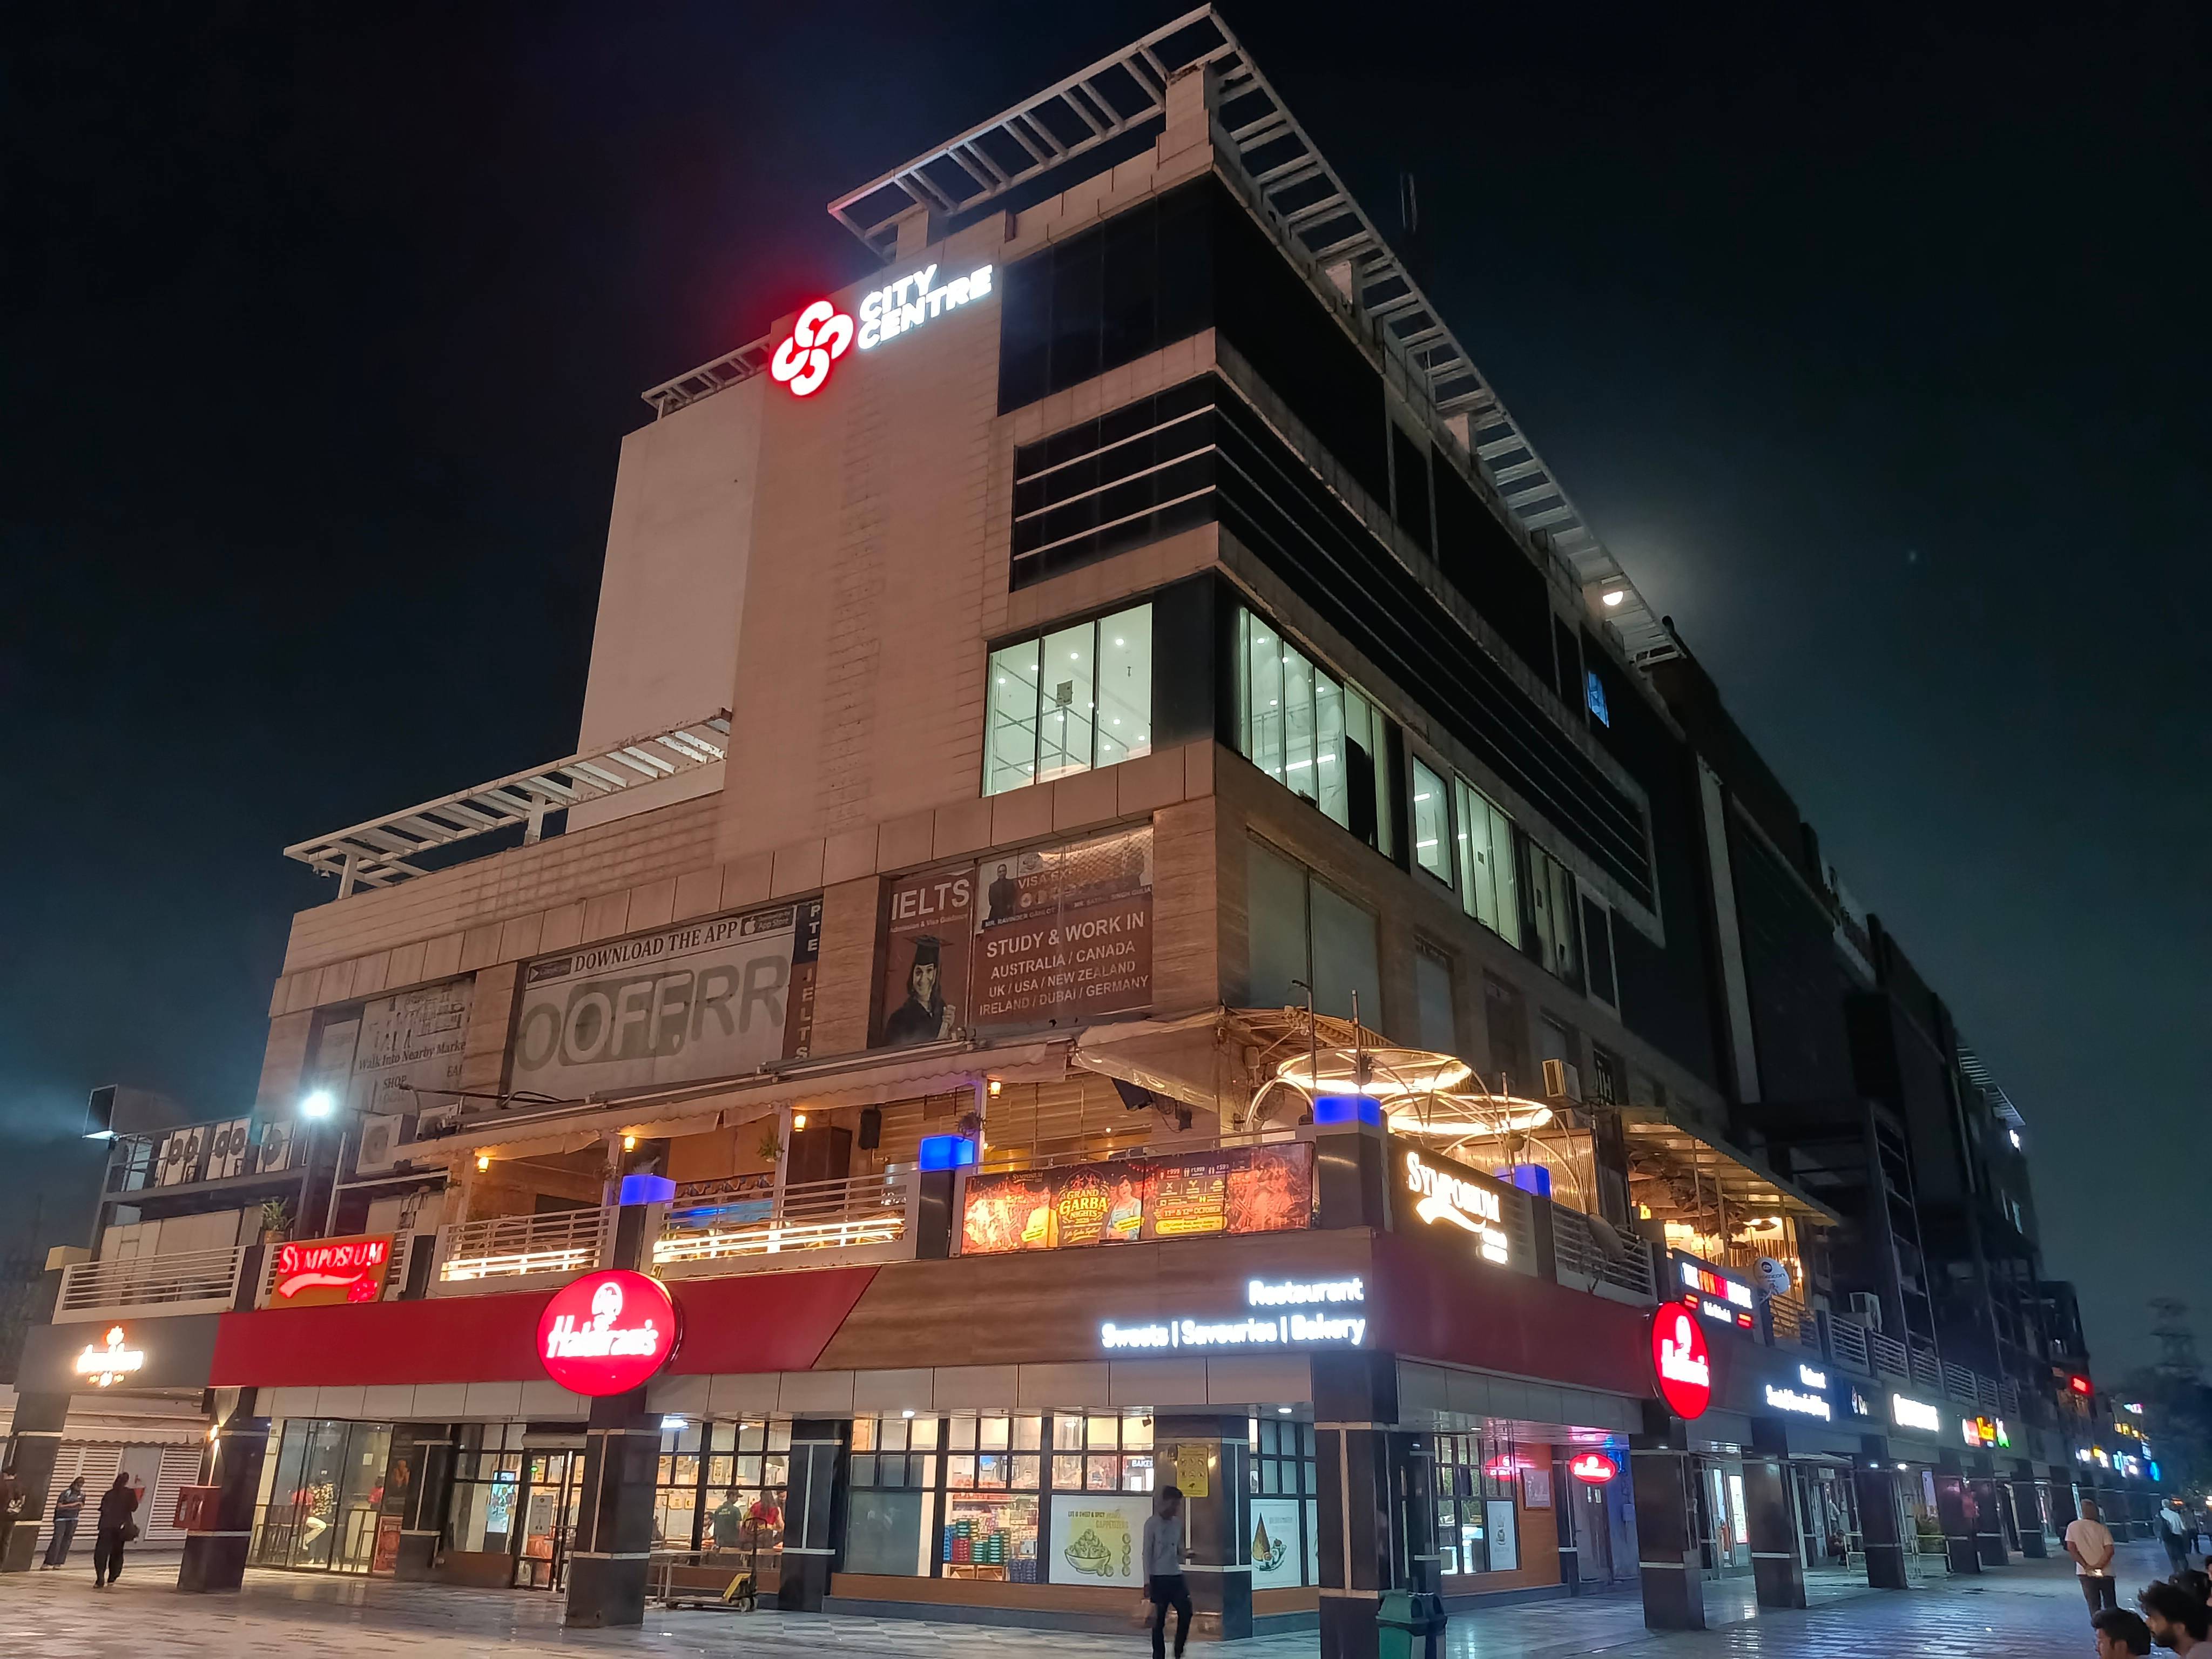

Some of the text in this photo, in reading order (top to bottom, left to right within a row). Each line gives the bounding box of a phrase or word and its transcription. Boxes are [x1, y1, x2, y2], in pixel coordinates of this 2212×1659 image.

[858, 264, 993, 350] CENTRE
[859, 264, 938, 323] CITY
[1018, 874, 1047, 889] VISA
[892, 879, 970, 920] IELTS
[759, 921, 771, 930] App
[987, 911, 1144, 957] STUDY & WORK IN
[575, 938, 664, 972] DOWNLOAD
[669, 928, 701, 951] THE
[704, 921, 738, 944] APP
[991, 954, 1065, 980] AUSTRALIA
[1076, 940, 1135, 963] CANADA
[980, 997, 1029, 1016] IRELAND
[1040, 989, 1076, 1006] DUBAI
[1086, 975, 1149, 997] GERMANY
[989, 983, 1004, 998] UK
[1015, 979, 1038, 993] USA
[1048, 972, 1075, 987] NEW
[1078, 961, 1135, 982] ZEALAND
[360, 1056, 380, 1070] Walk
[382, 1054, 400, 1066] Into
[402, 1044, 435, 1062] Nearby
[383, 1075, 407, 1089] SHOP
[1059, 1197, 1108, 1215] GARBA
[1067, 1189, 1099, 1200] GRAND
[1070, 1210, 1098, 1219] NIGHTS
[279, 1242, 384, 1273] SYMPOSIUM
[1249, 1277, 1364, 1306] Restaurant
[1102, 1324, 1169, 1348] Sweets
[1181, 1318, 1278, 1345] Savouries
[1291, 1313, 1366, 1345] Bakery
